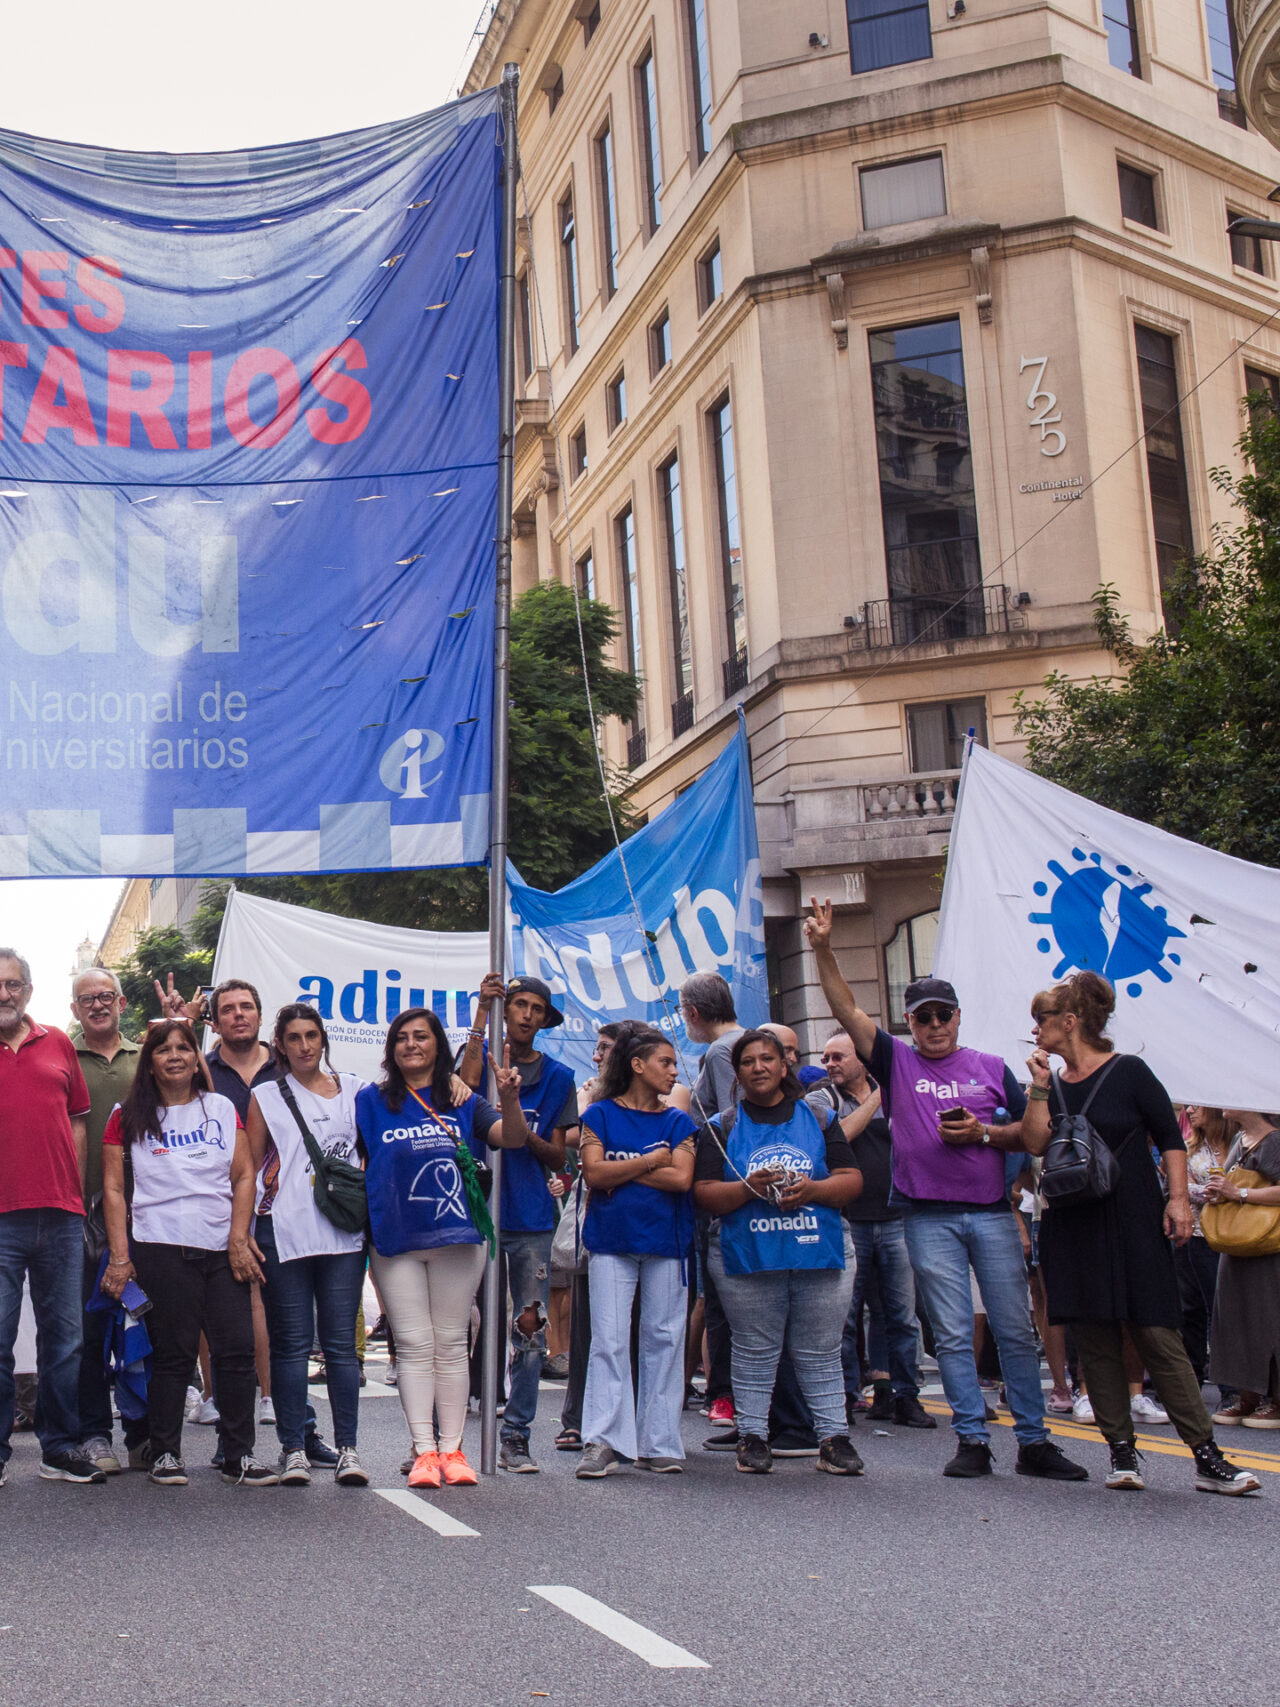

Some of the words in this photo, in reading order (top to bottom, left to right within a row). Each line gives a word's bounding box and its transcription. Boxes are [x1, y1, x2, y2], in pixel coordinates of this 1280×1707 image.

[1019, 354, 1067, 458] 725
[1019, 476, 1083, 494] Continental
[1052, 489, 1083, 503] Hotel
[9, 681, 182, 723] Nacional
[199, 681, 247, 723] de
[327, 1034, 374, 1045] NIVERSIDAD
[360, 1029, 387, 1037] DOCEN
[749, 1212, 818, 1232] conadu
